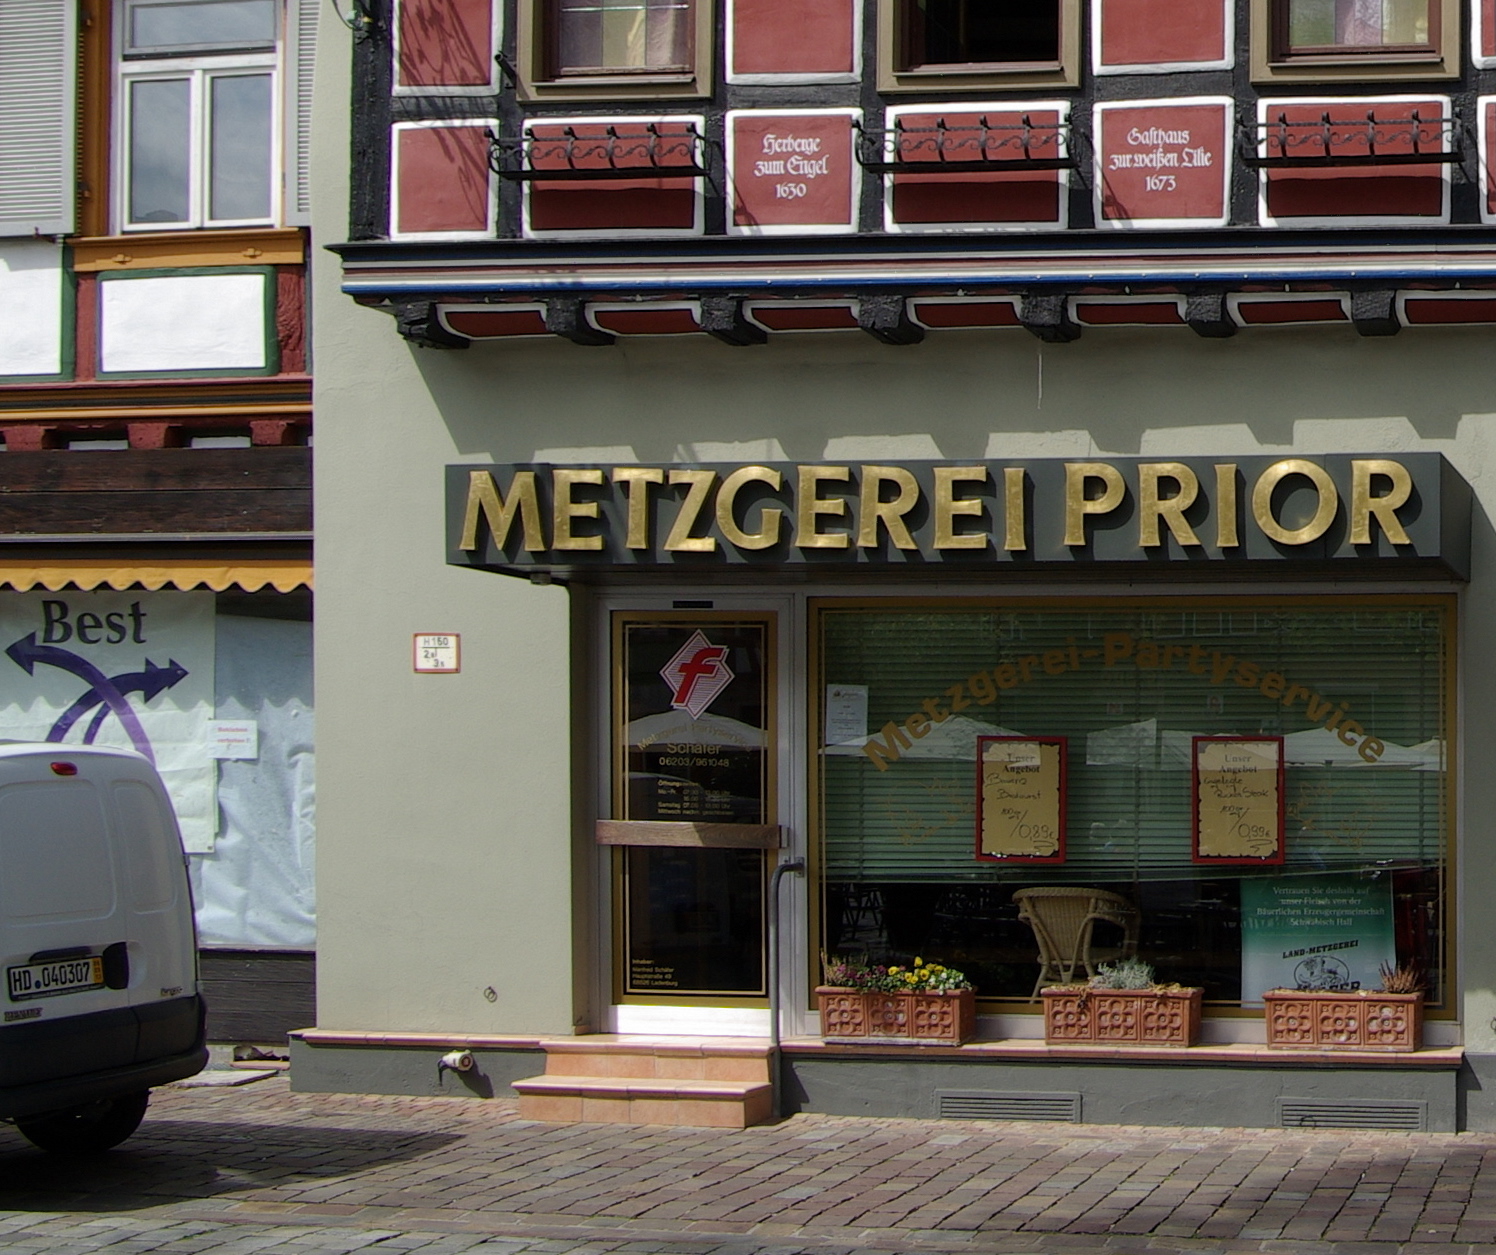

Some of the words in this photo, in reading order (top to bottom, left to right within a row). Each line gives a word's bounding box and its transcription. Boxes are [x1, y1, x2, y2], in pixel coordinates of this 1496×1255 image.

[762, 133, 821, 155] Herberge
[754, 160, 785, 177] zum
[786, 154, 830, 178] Engel
[1180, 146, 1213, 168] Lilie
[775, 181, 807, 199] 1630
[1145, 174, 1177, 192] 1673
[458, 464, 1027, 552] METZGEREI
[1062, 459, 1414, 547] PRIOR
[41, 599, 147, 644] Best
[860, 632, 1386, 772] Metzgerei-Partyservice
[1224, 754, 1252, 763] Unser
[1003, 764, 1041, 775] Angebot
[1219, 765, 1257, 775] Angebot
[1312, 887, 1324, 895] Sie
[1337, 918, 1352, 926] Hall
[1282, 939, 1359, 959] LAND-METZGEREI
[13, 970, 32, 992] HD
[41, 961, 90, 987] 040307
